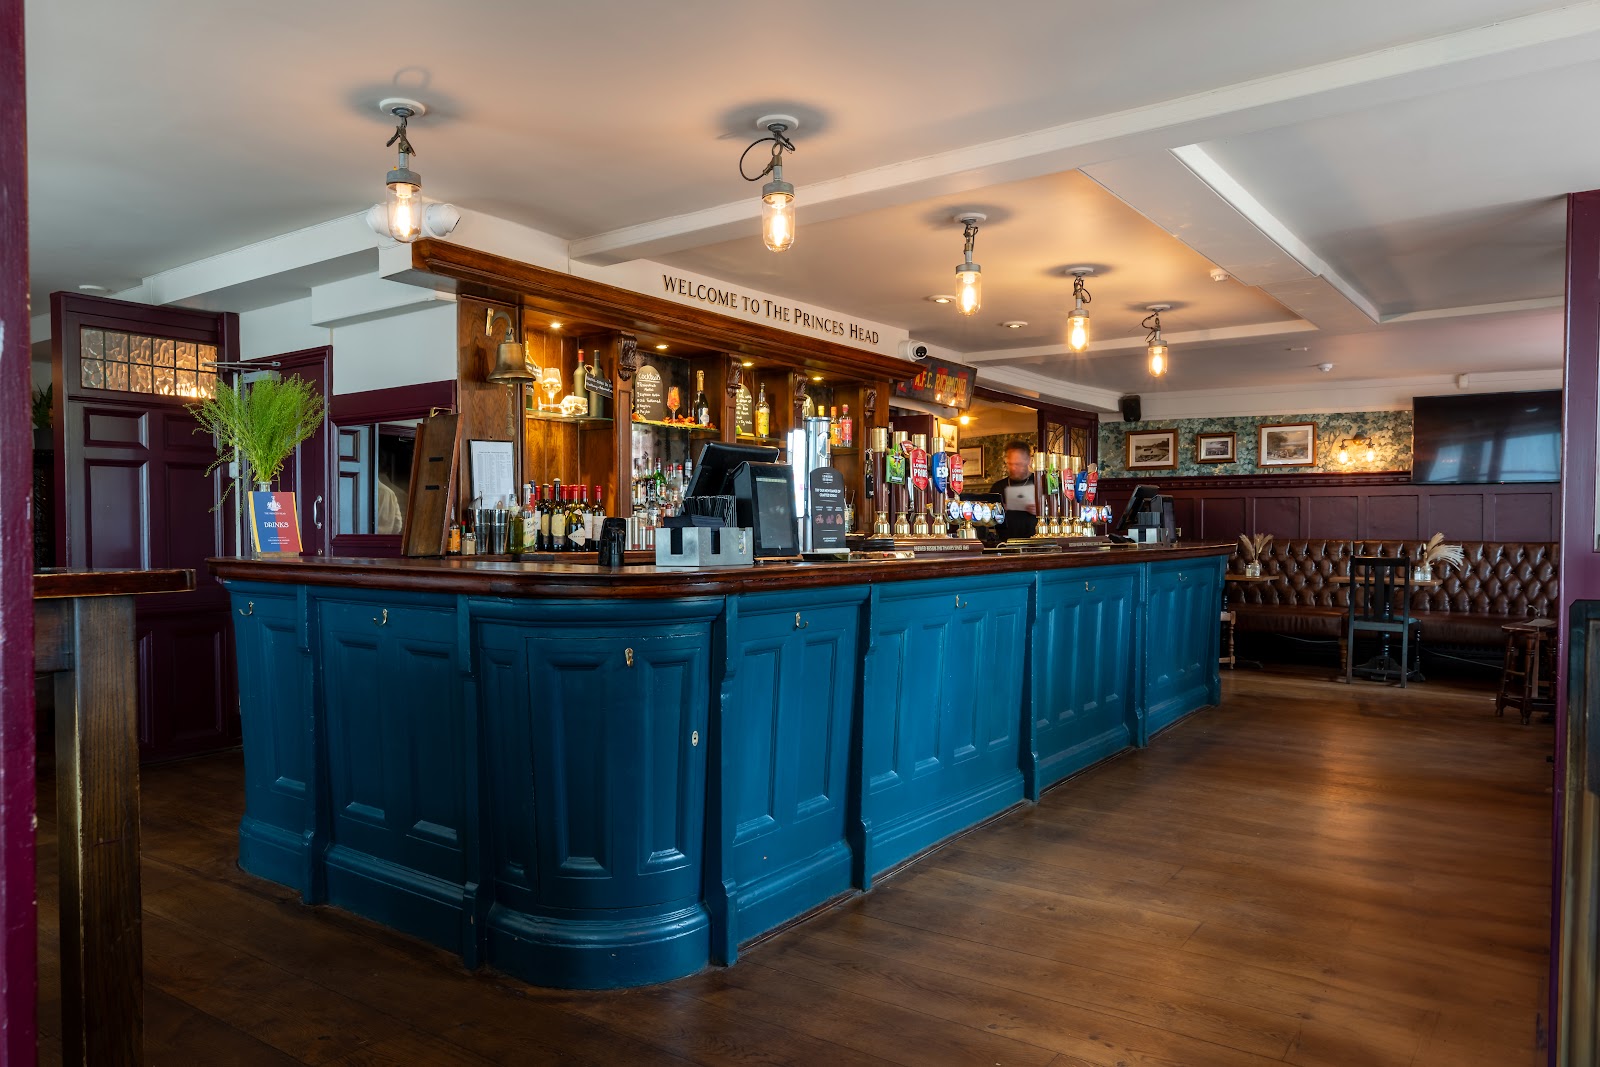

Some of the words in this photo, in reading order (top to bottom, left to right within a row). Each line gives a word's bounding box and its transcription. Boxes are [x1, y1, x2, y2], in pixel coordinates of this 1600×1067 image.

[663, 274, 738, 309] WELCOME
[741, 295, 760, 314] TO
[764, 299, 790, 322] THE
[794, 308, 844, 336] PRINCES
[850, 323, 879, 344] HEAD
